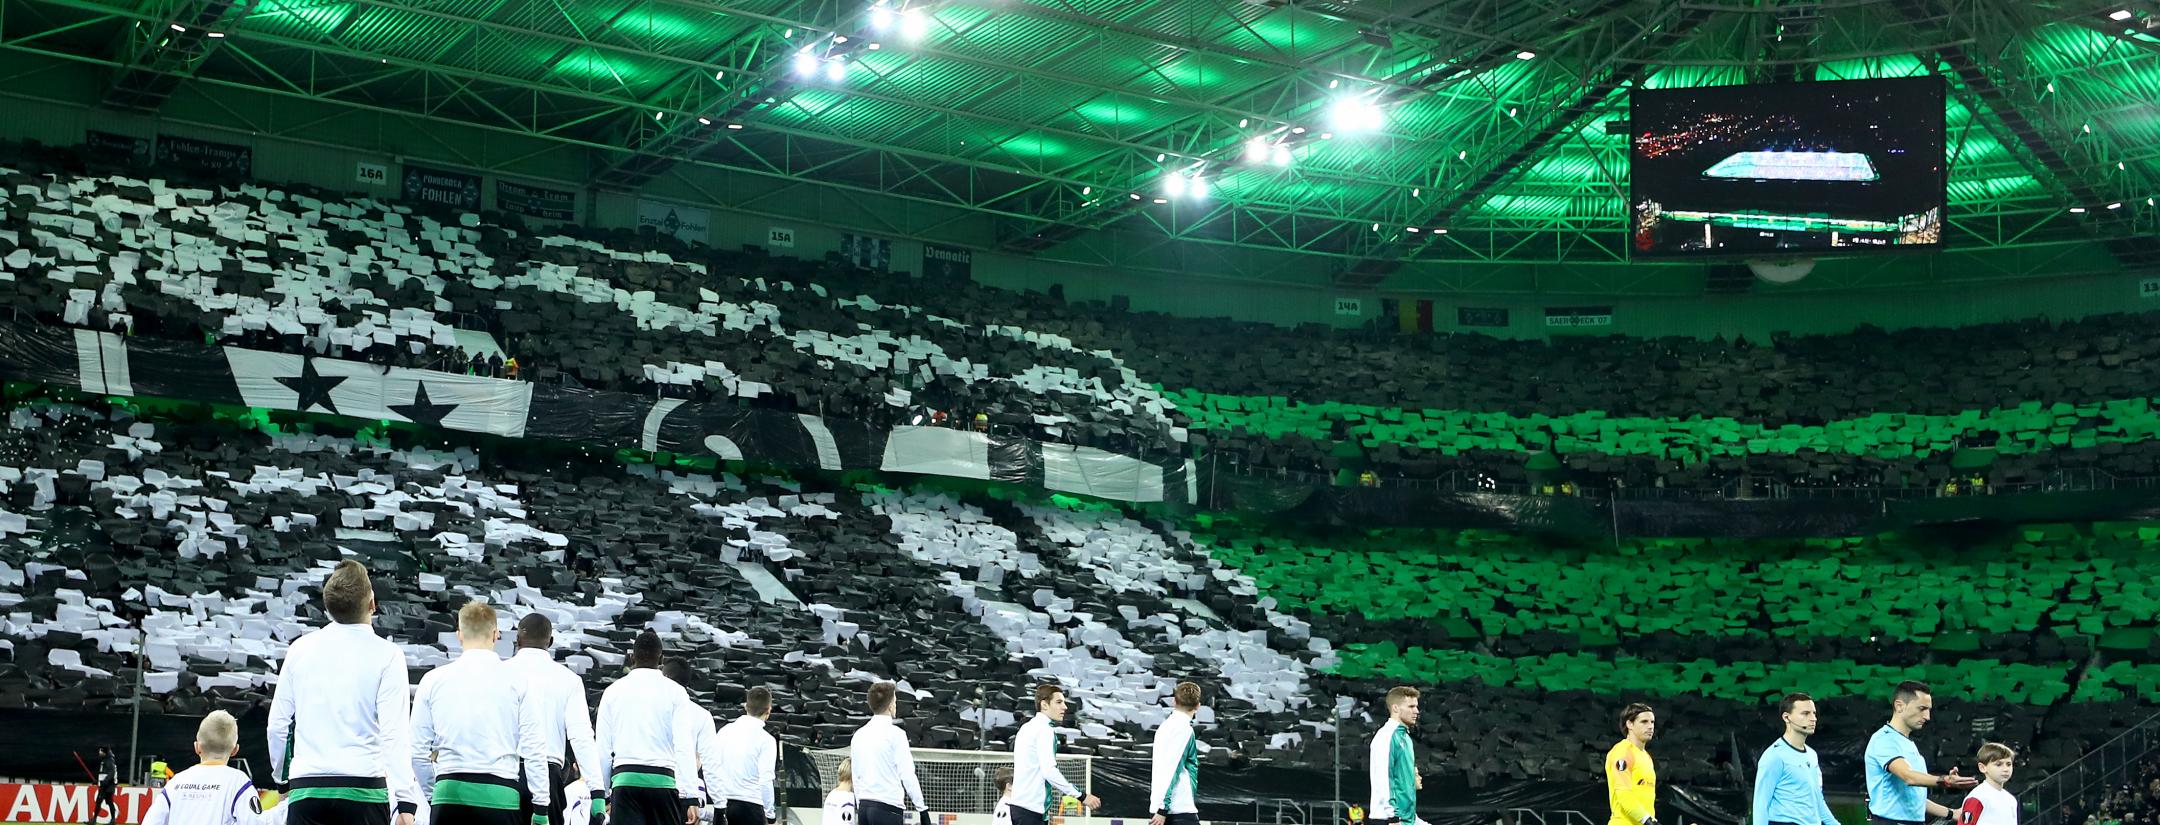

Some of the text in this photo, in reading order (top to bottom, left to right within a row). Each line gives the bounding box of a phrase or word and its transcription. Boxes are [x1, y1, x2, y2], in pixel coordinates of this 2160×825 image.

[360, 167, 383, 180] 16A
[422, 187, 462, 206] FOHLEN
[771, 231, 791, 243] 15A
[2143, 282, 2160, 292] 13
[1338, 301, 1358, 311] 14A
